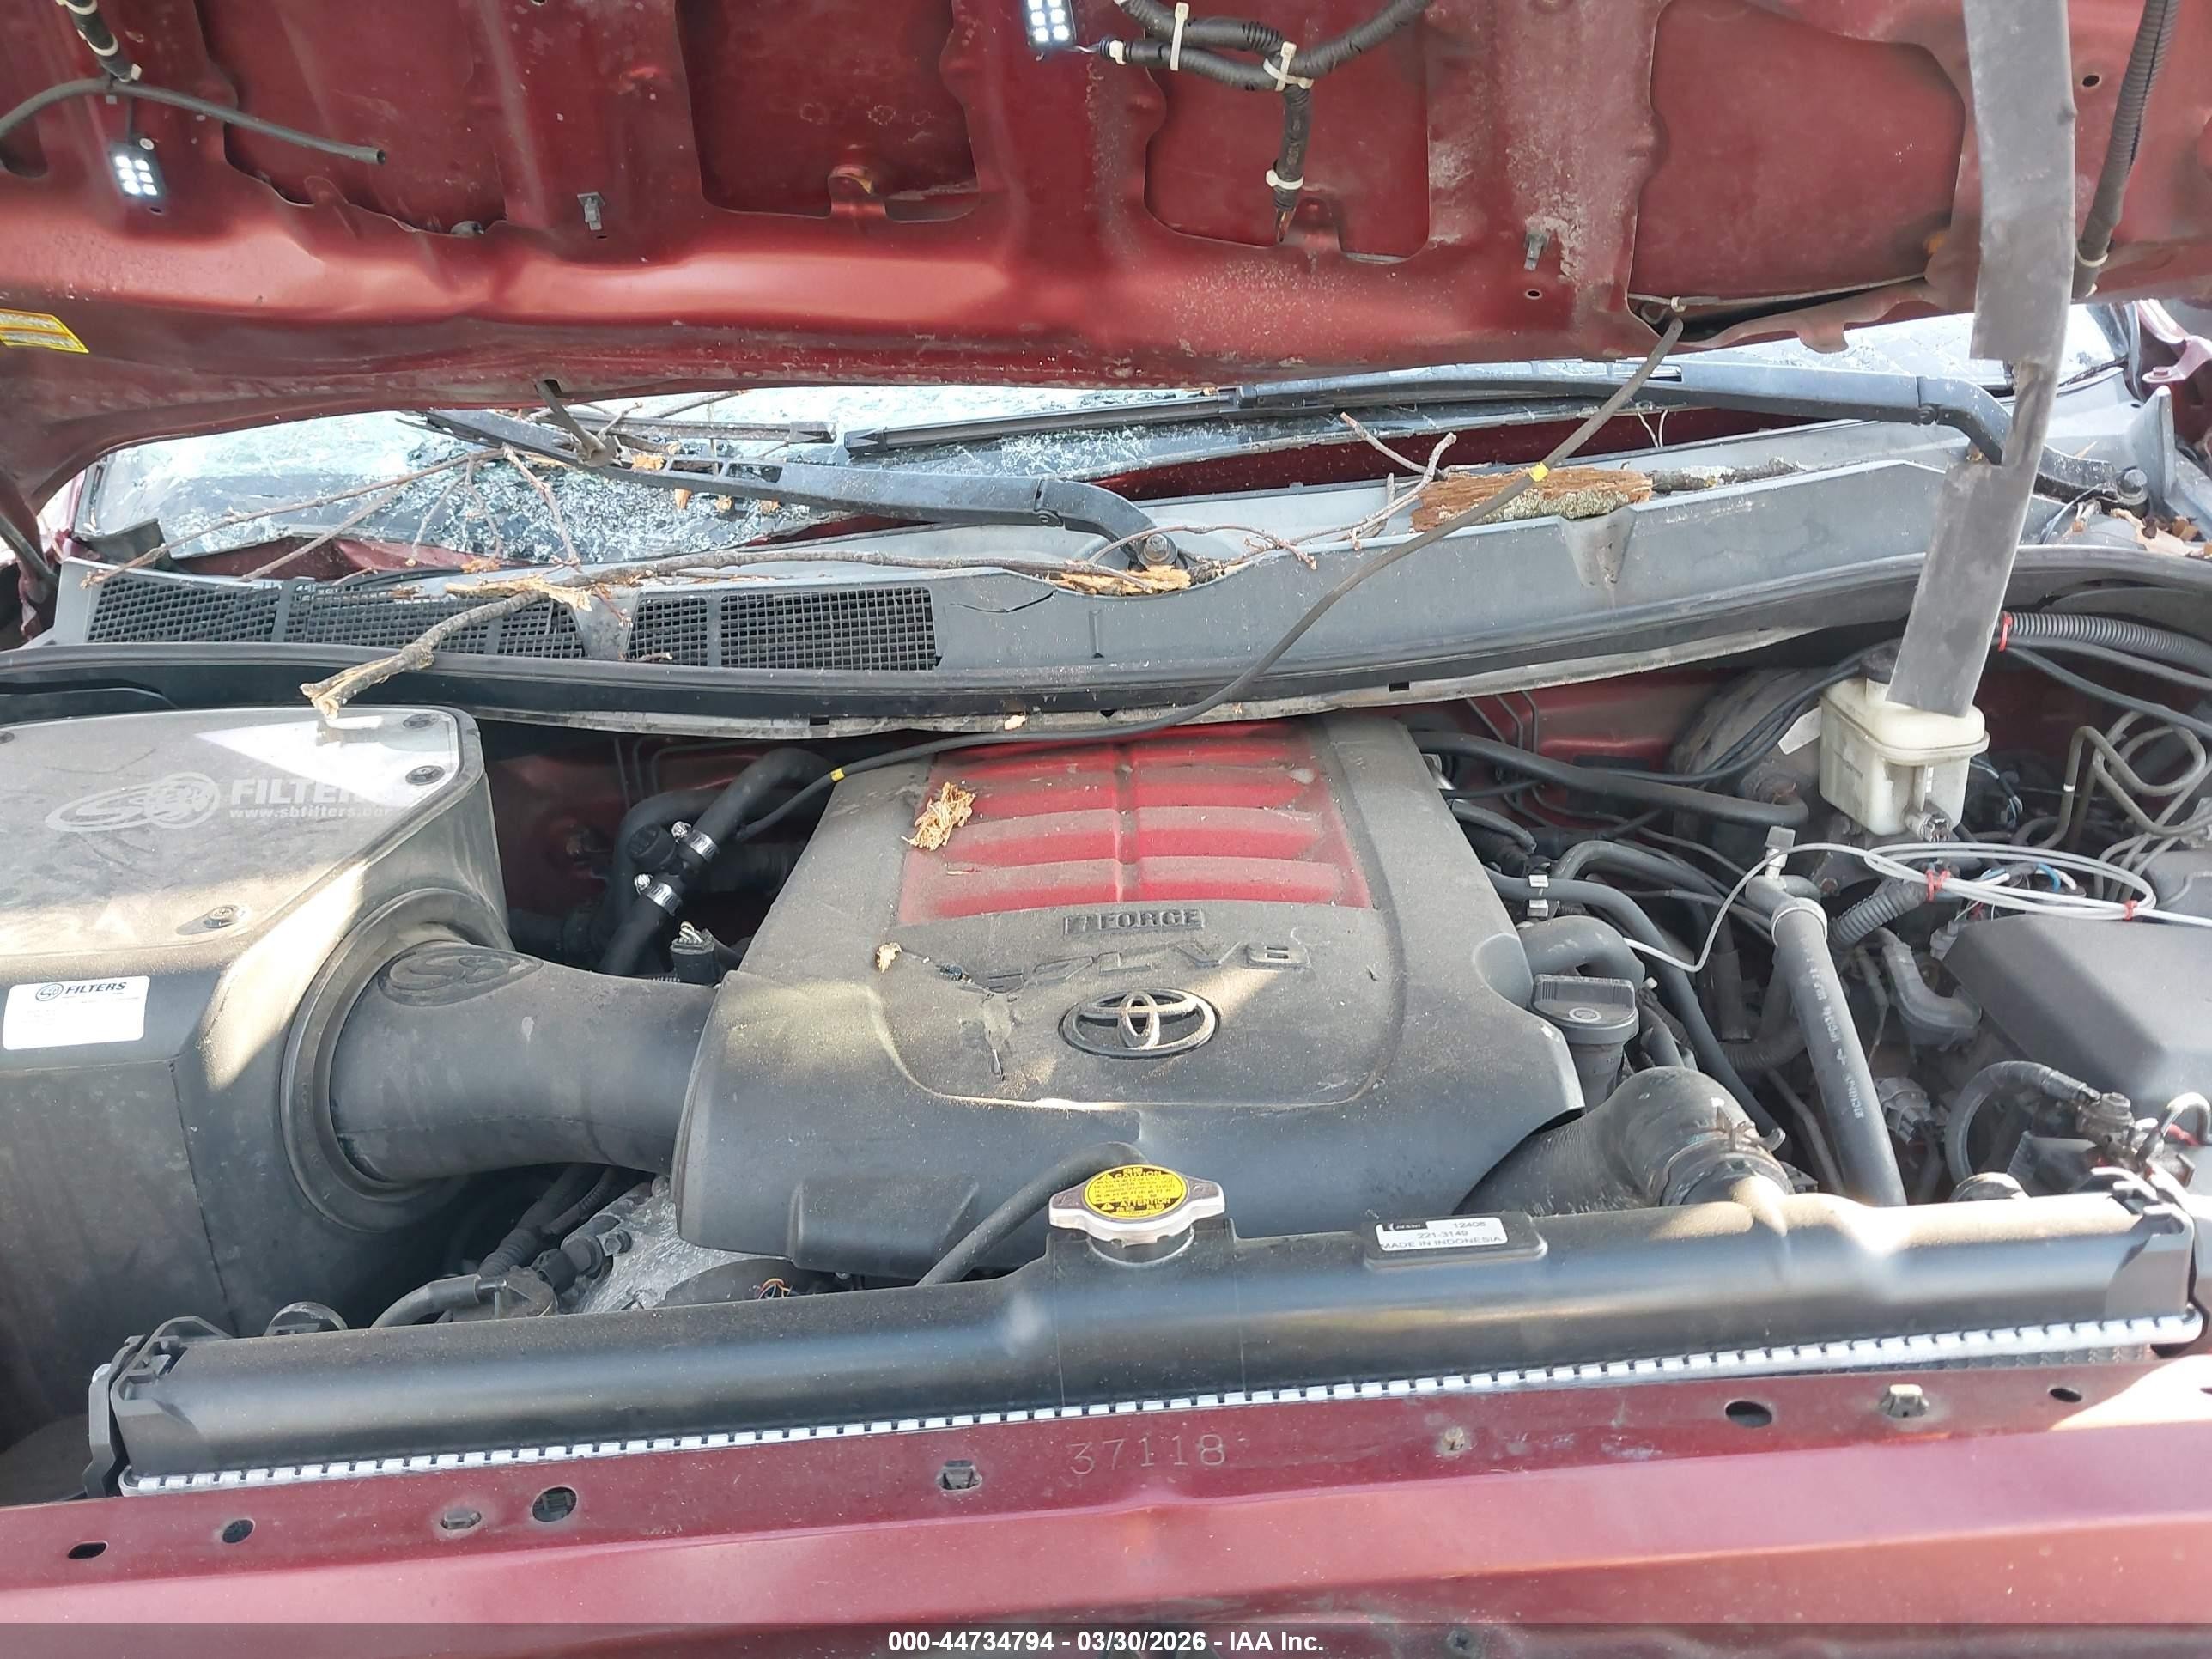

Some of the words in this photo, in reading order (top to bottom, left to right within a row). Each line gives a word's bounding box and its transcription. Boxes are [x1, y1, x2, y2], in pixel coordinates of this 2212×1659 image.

[65, 981, 127, 994] FILTERS
[1120, 1197, 1171, 1206] ATTENTION
[1381, 1241, 1415, 1249] MADE
[1434, 1237, 1502, 1247] INDONESIA
[1067, 1432, 1225, 1475] 37118
